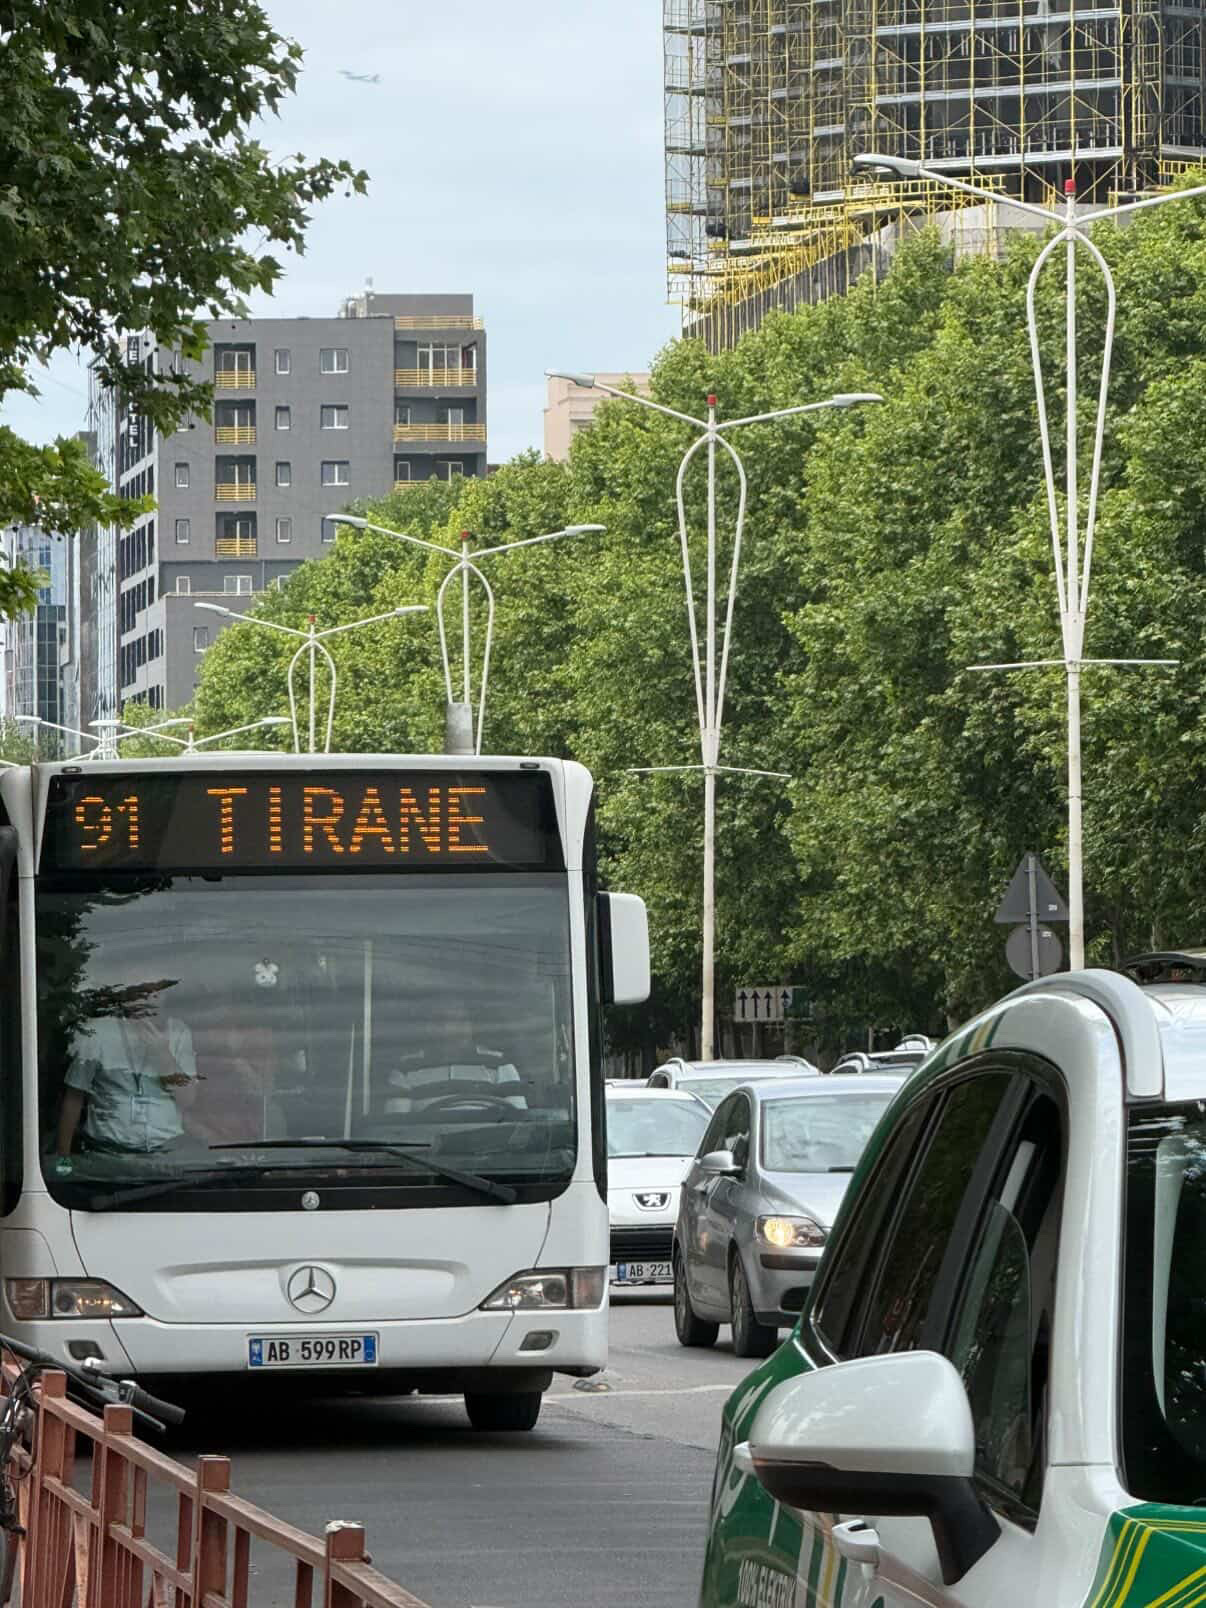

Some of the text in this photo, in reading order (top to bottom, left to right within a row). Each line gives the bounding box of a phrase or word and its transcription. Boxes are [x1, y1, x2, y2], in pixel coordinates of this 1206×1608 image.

[75, 786, 489, 853] 91 TIRANE
[630, 1263, 672, 1277] AB 221
[267, 1341, 290, 1361] AB
